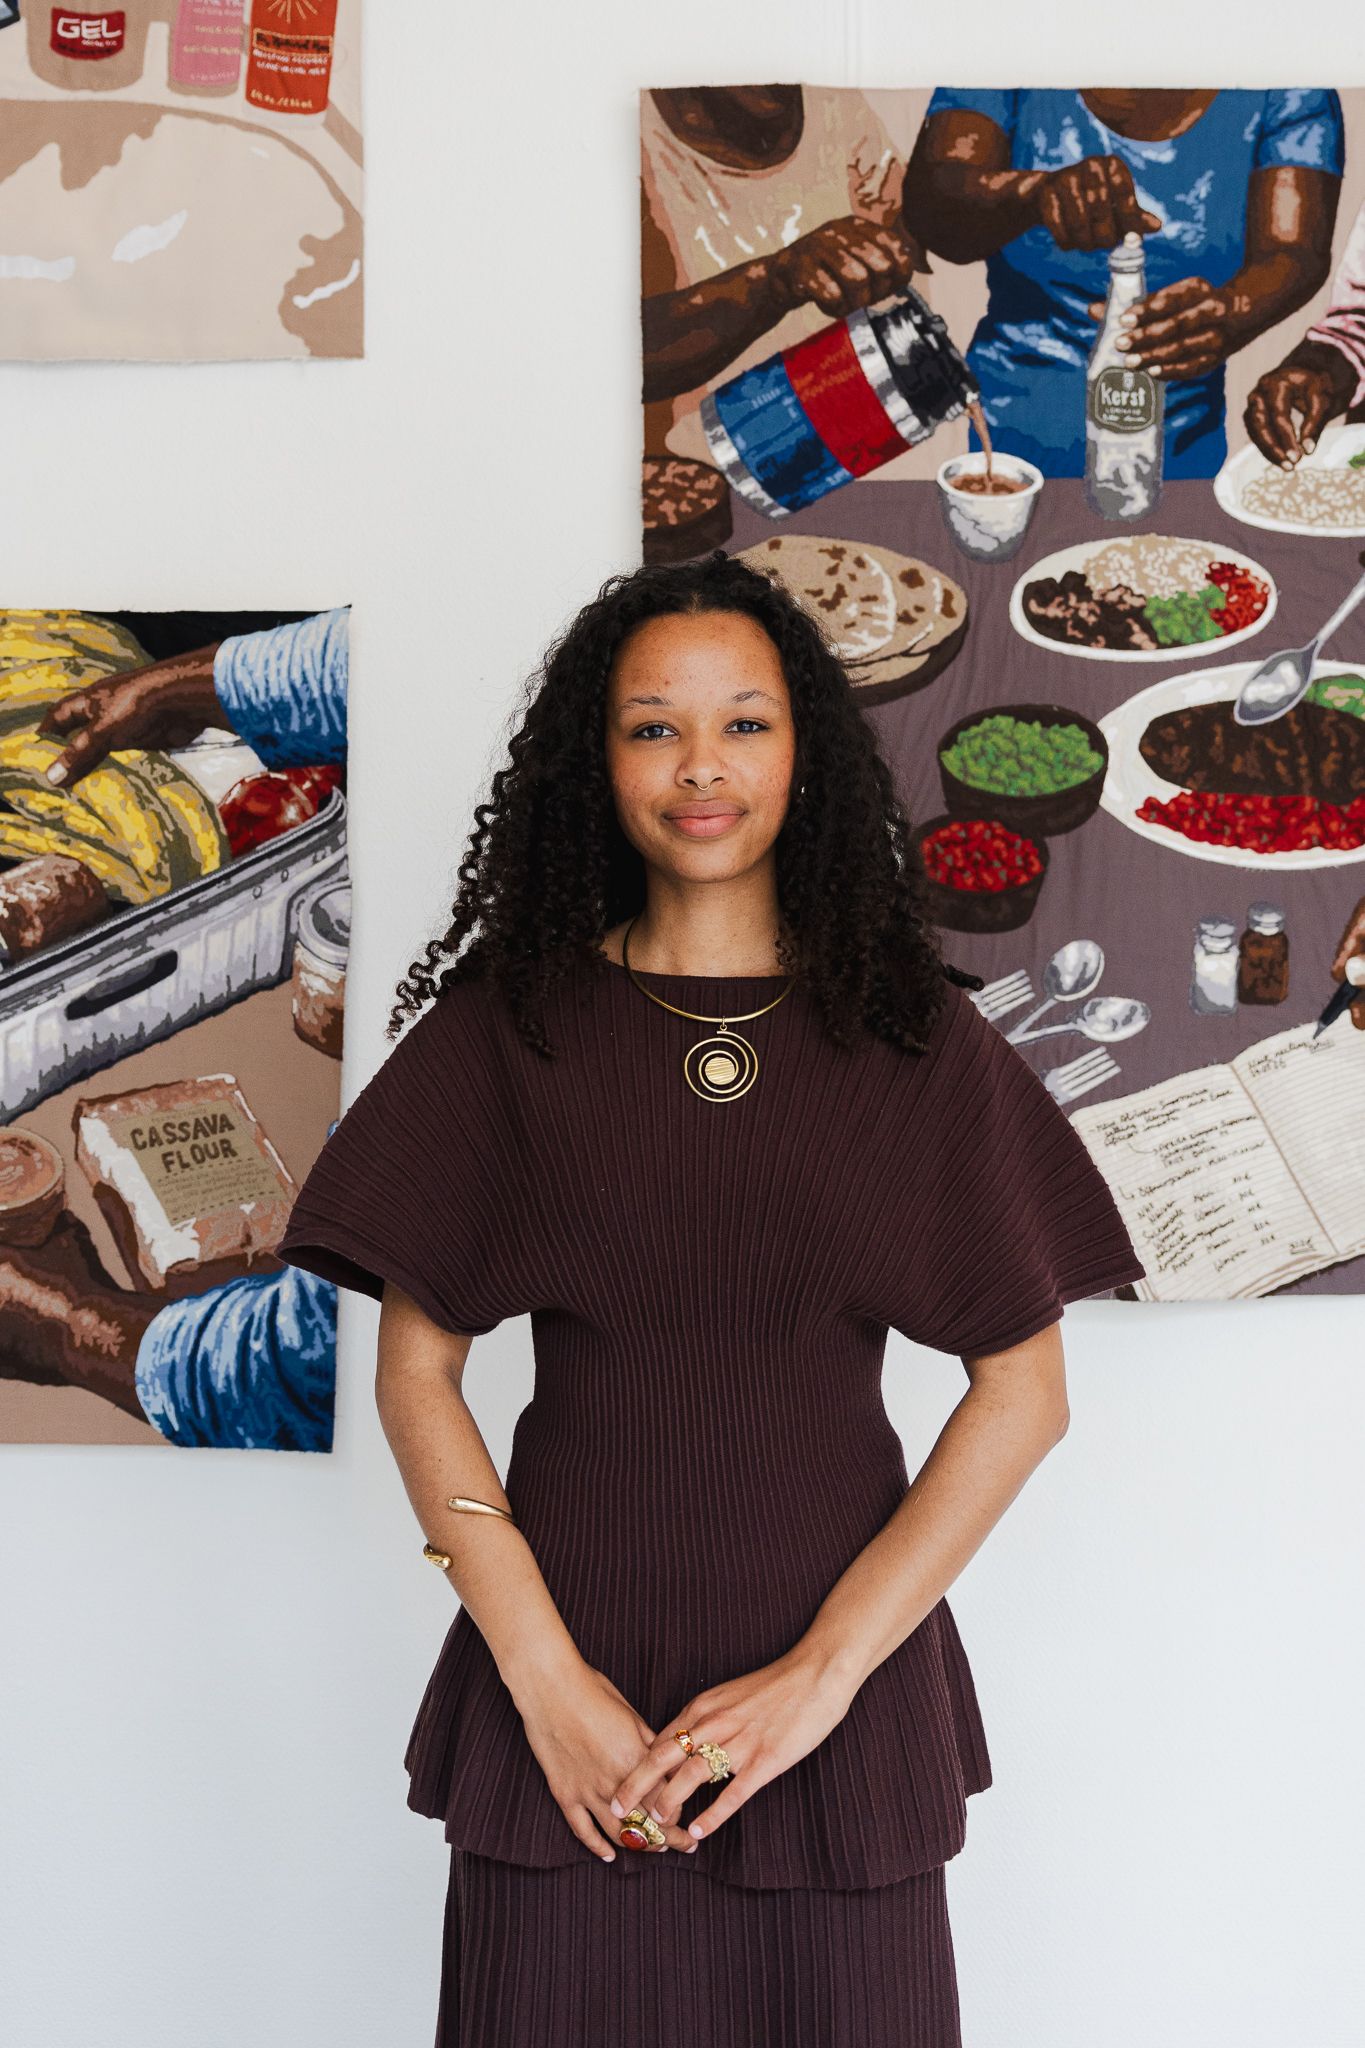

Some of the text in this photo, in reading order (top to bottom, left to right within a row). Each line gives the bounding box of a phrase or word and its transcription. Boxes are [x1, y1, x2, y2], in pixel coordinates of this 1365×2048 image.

[56, 17, 123, 40] GEL
[130, 1113, 236, 1151] CASSAVA
[161, 1138, 238, 1173] FLOUR
